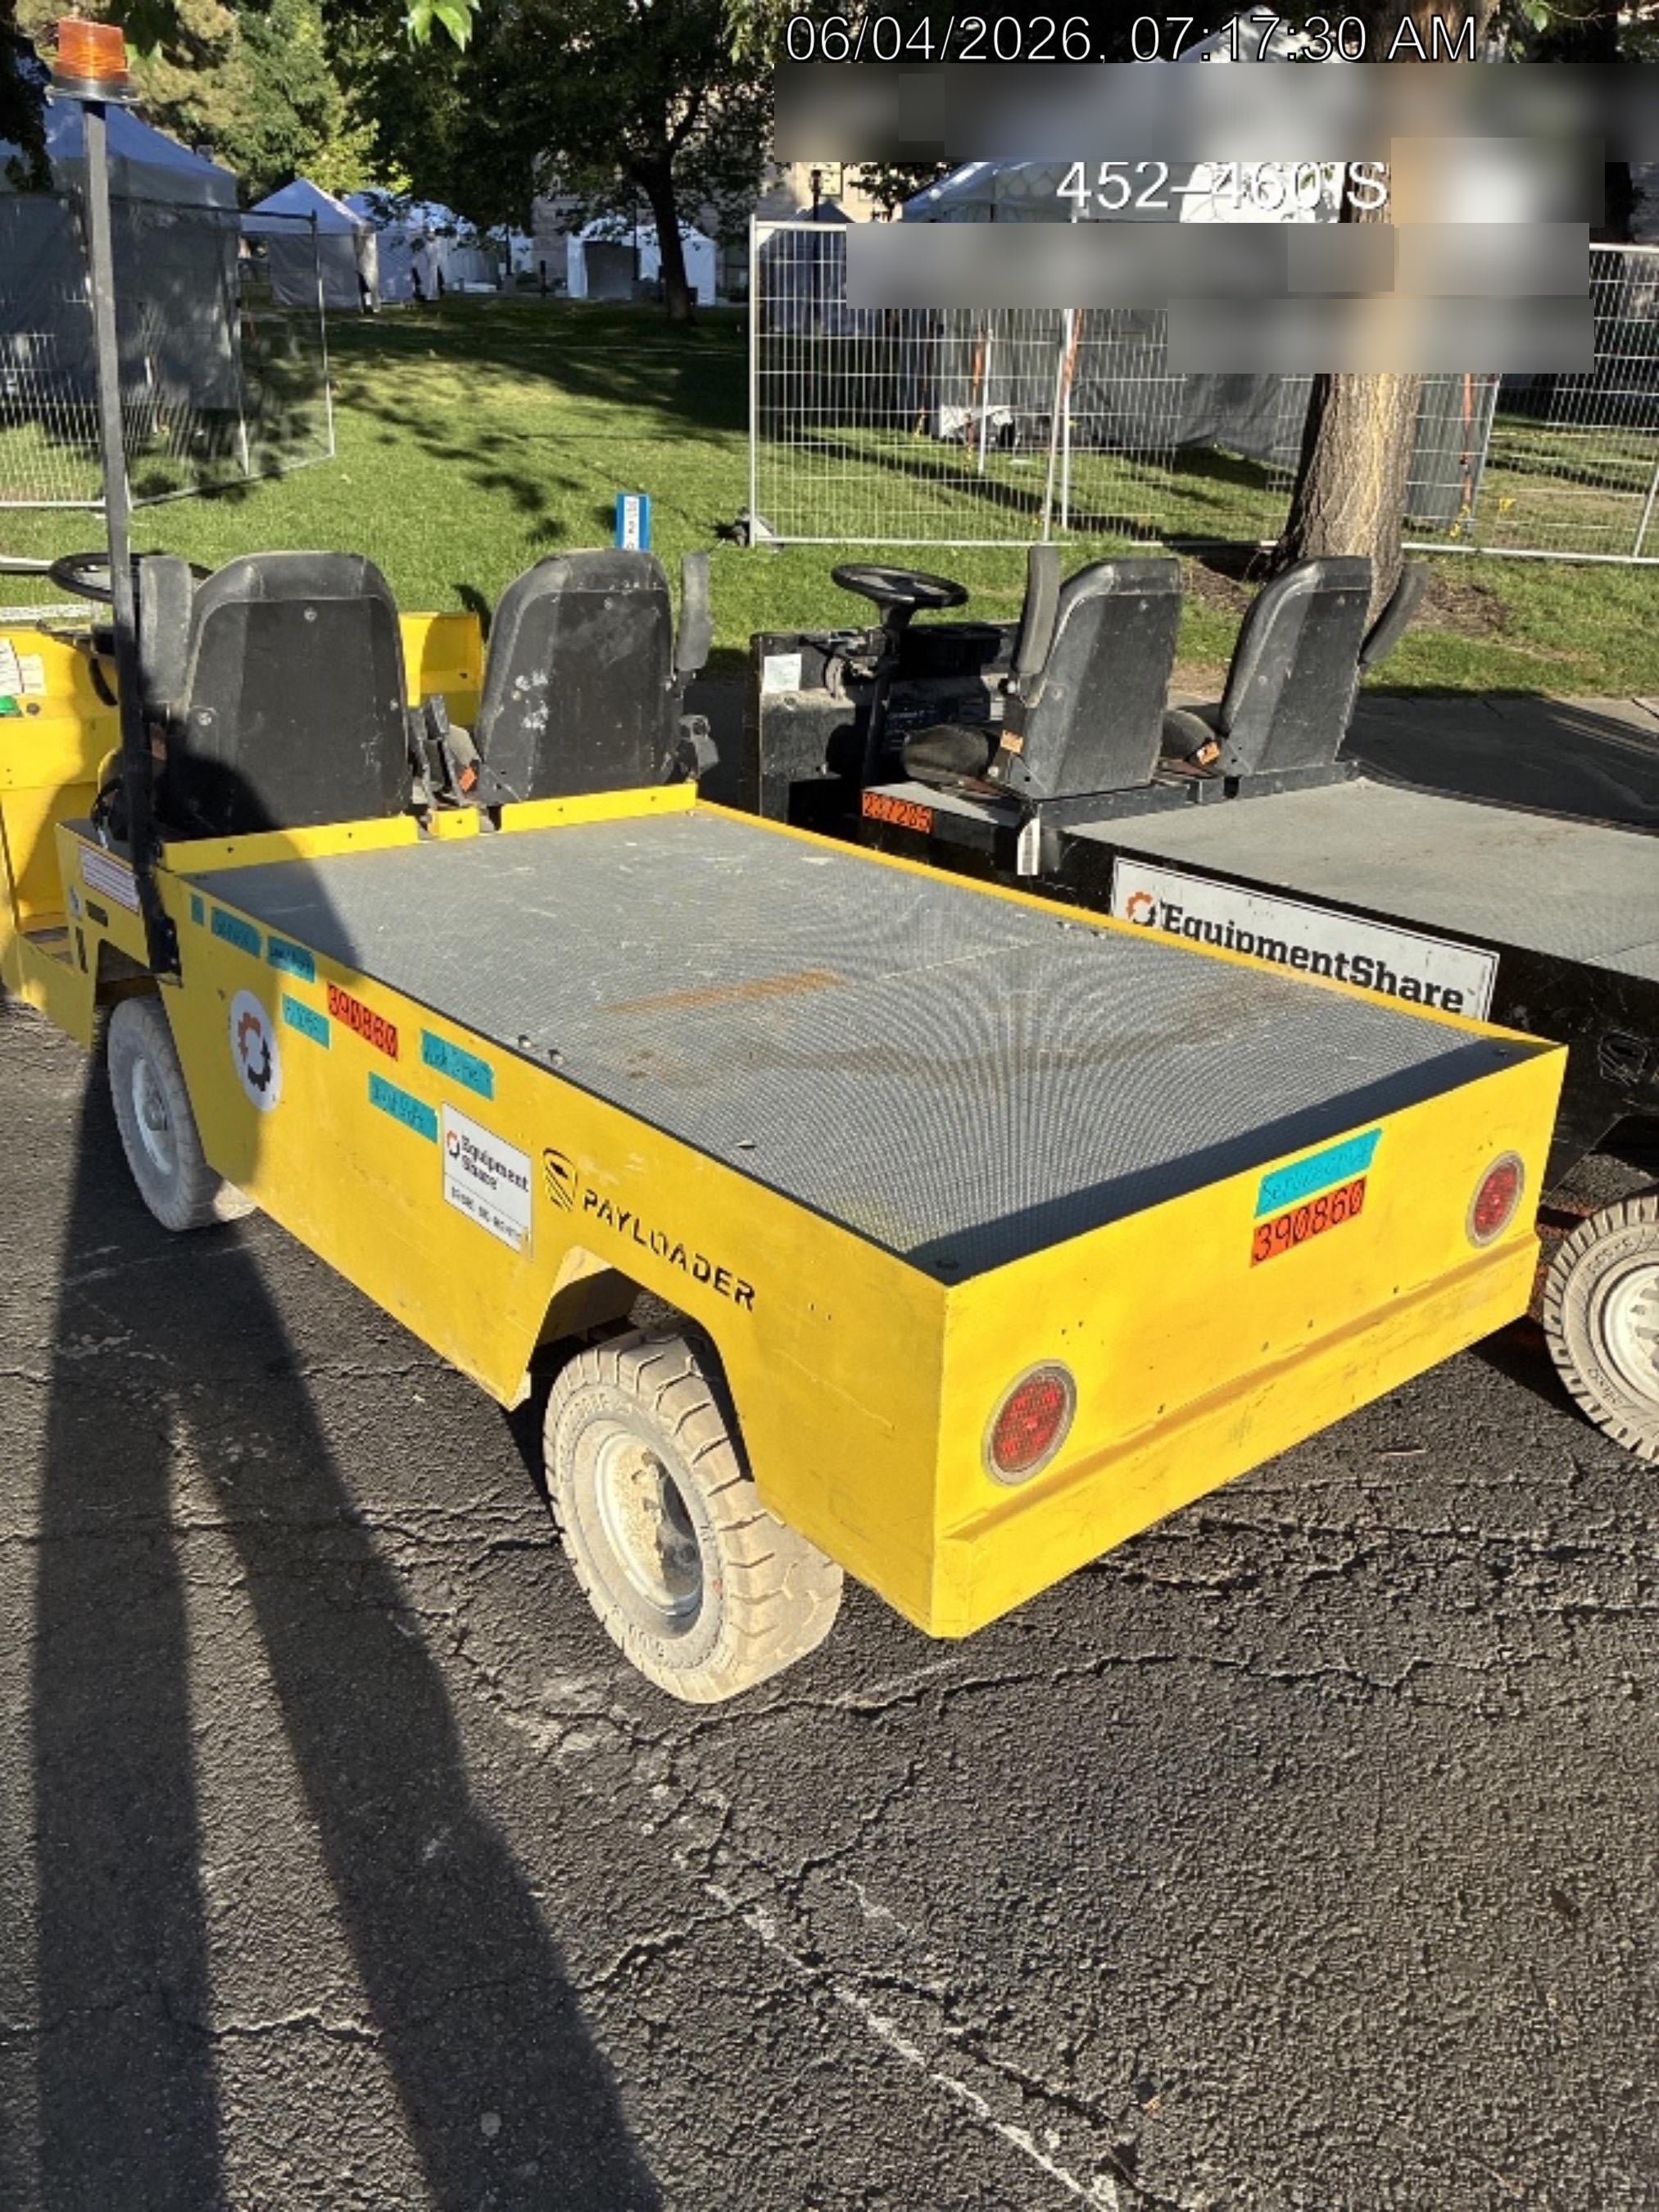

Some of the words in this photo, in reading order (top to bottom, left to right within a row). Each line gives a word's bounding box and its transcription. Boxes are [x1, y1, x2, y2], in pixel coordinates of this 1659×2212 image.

[1162, 902, 1463, 1014] EquipmentShare
[582, 1188, 755, 1312] PAYLOADER
[1254, 1177, 1367, 1262] 390860
